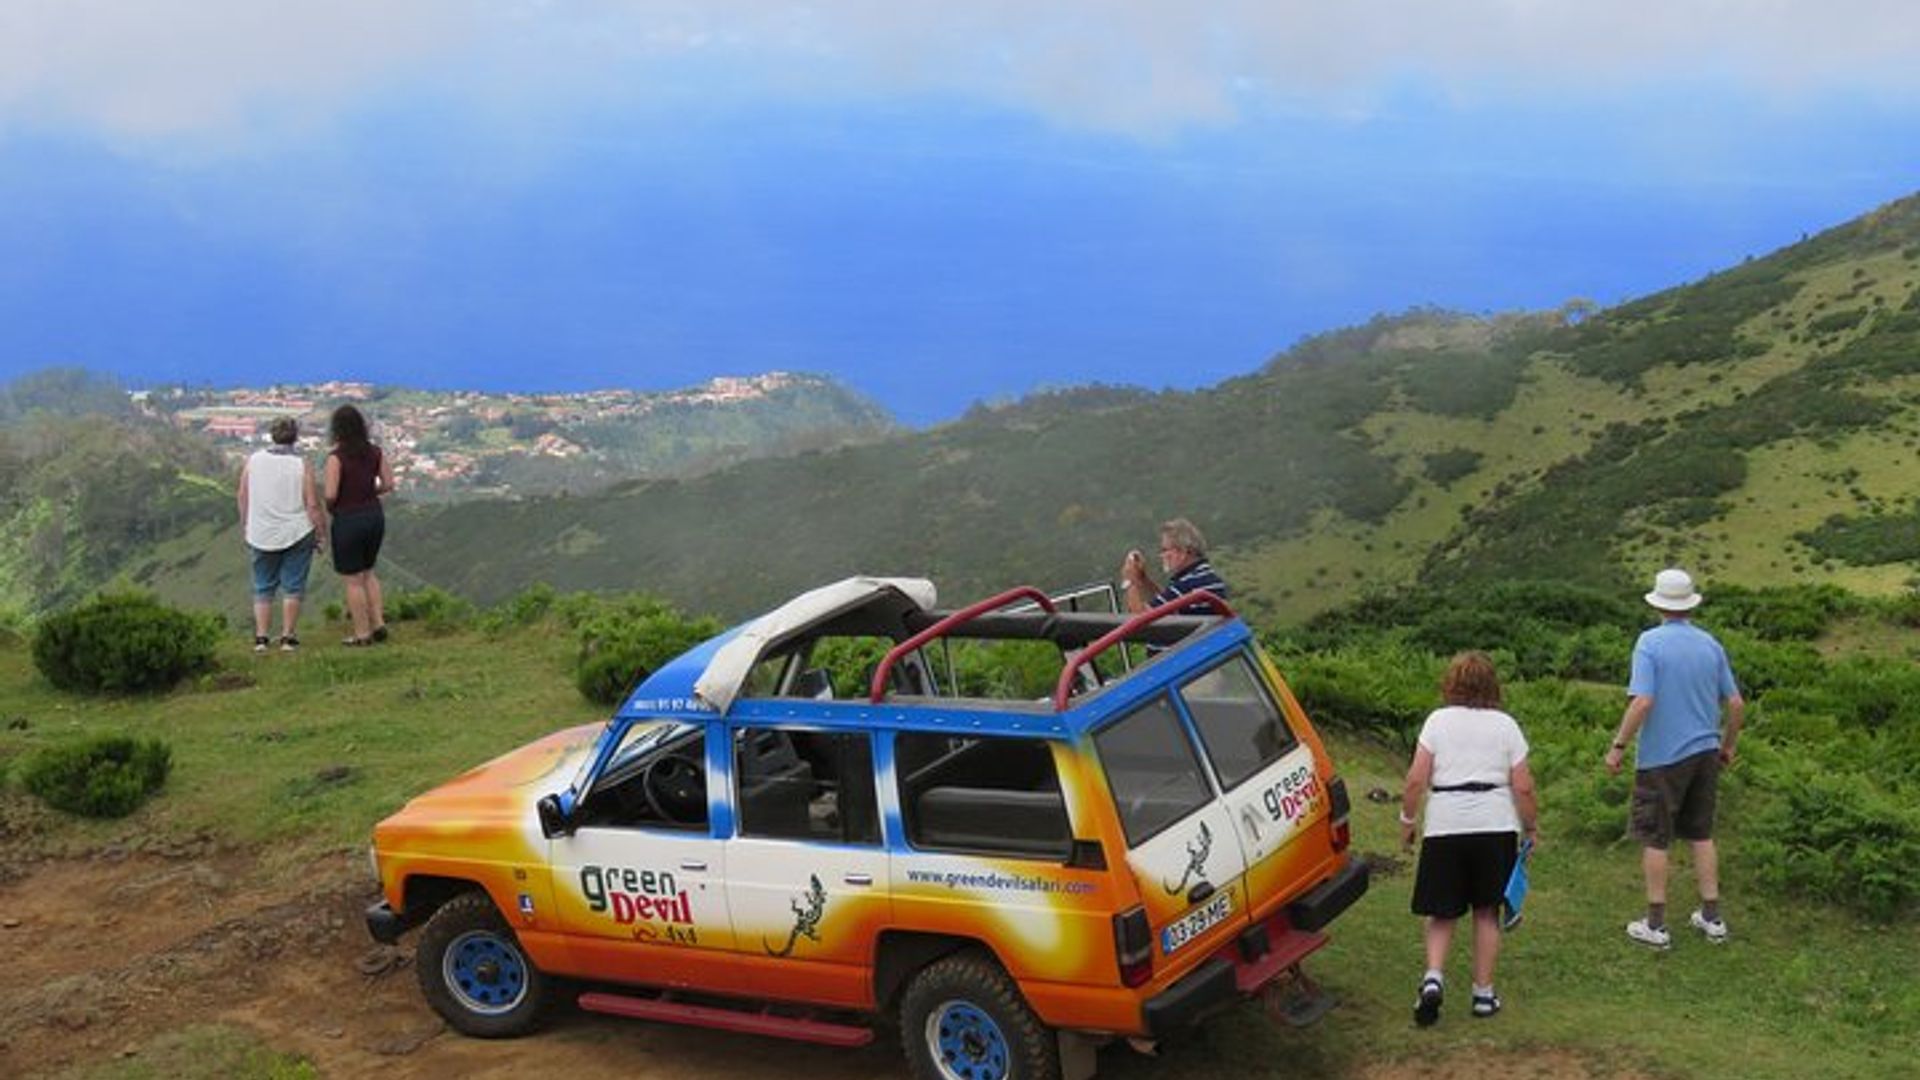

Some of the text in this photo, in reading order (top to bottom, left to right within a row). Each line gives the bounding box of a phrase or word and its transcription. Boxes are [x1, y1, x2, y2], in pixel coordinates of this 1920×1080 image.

[1264, 766, 1308, 822] green
[580, 865, 676, 912] green
[609, 890, 694, 925] Devil
